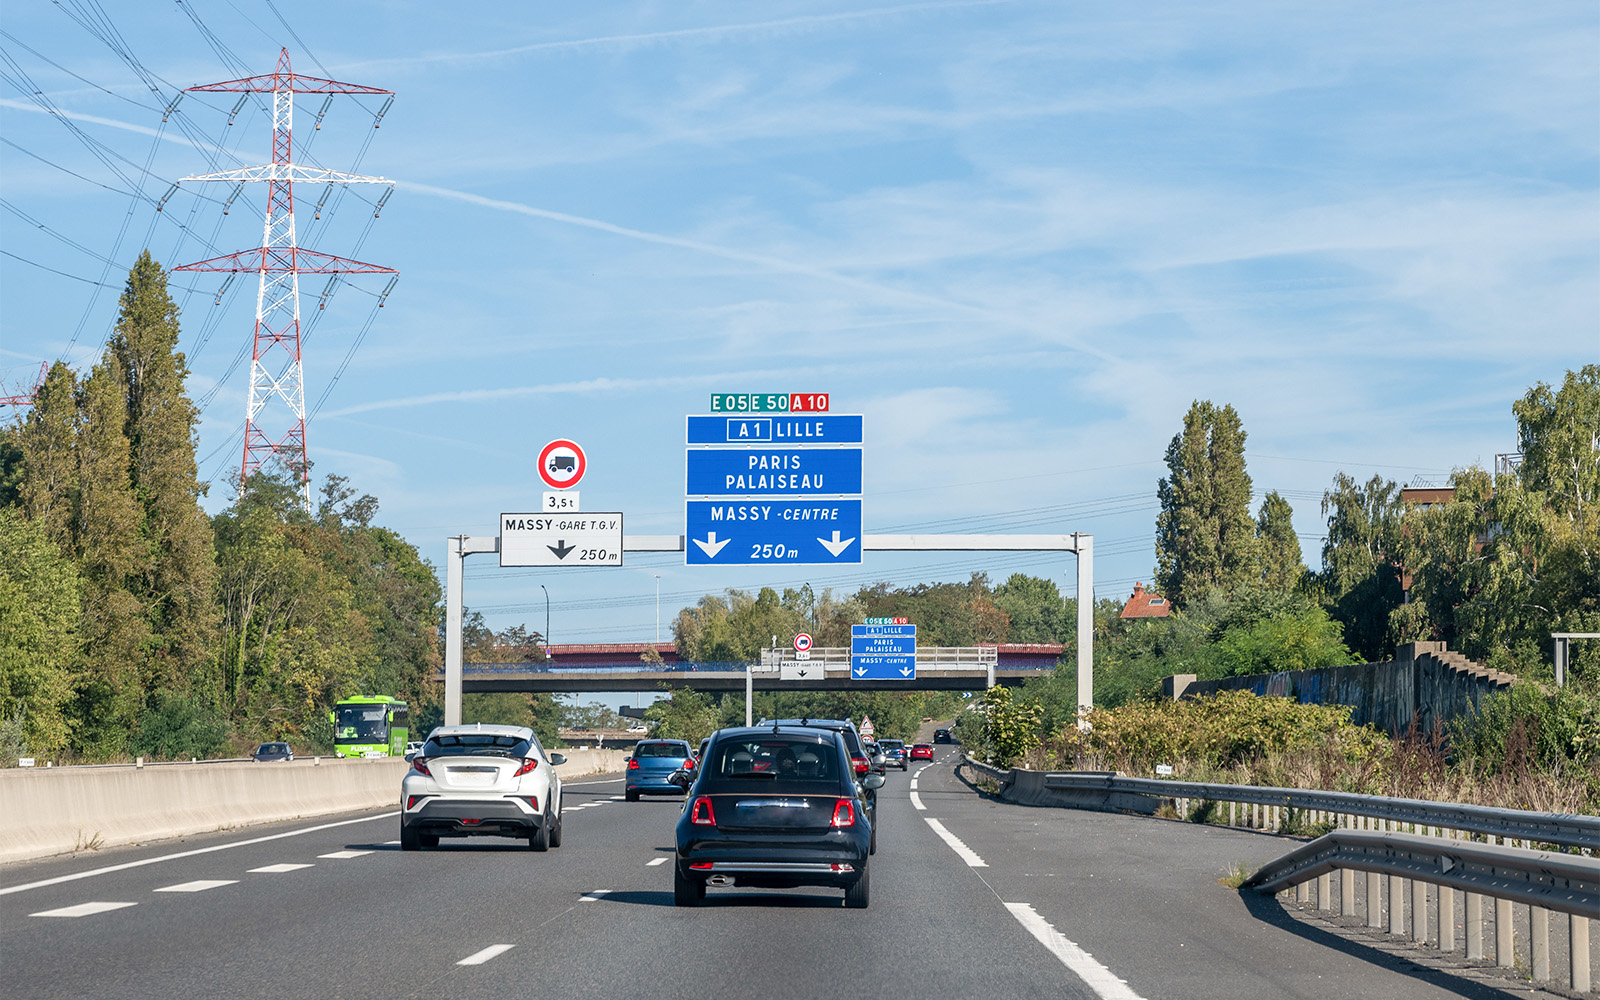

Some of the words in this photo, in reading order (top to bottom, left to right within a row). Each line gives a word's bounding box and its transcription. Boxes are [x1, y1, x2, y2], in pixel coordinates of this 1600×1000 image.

[712, 396, 720, 410] E
[726, 396, 748, 410] 05
[752, 396, 760, 410] E
[766, 396, 788, 410] 50
[792, 396, 802, 410] A
[808, 396, 826, 410] 10
[776, 422, 824, 437] LILLE
[749, 456, 800, 470] PARIS
[726, 474, 824, 489] PALAISEAU
[548, 496, 567, 508] 3,5
[712, 506, 771, 520] MASSY
[777, 508, 838, 520] -CENTRE
[506, 520, 552, 530] MASSY
[556, 521, 586, 530] -GARE
[590, 520, 618, 530] T.G.V.
[580, 550, 606, 560] 250
[750, 544, 786, 558] 250
[788, 550, 798, 558] m
